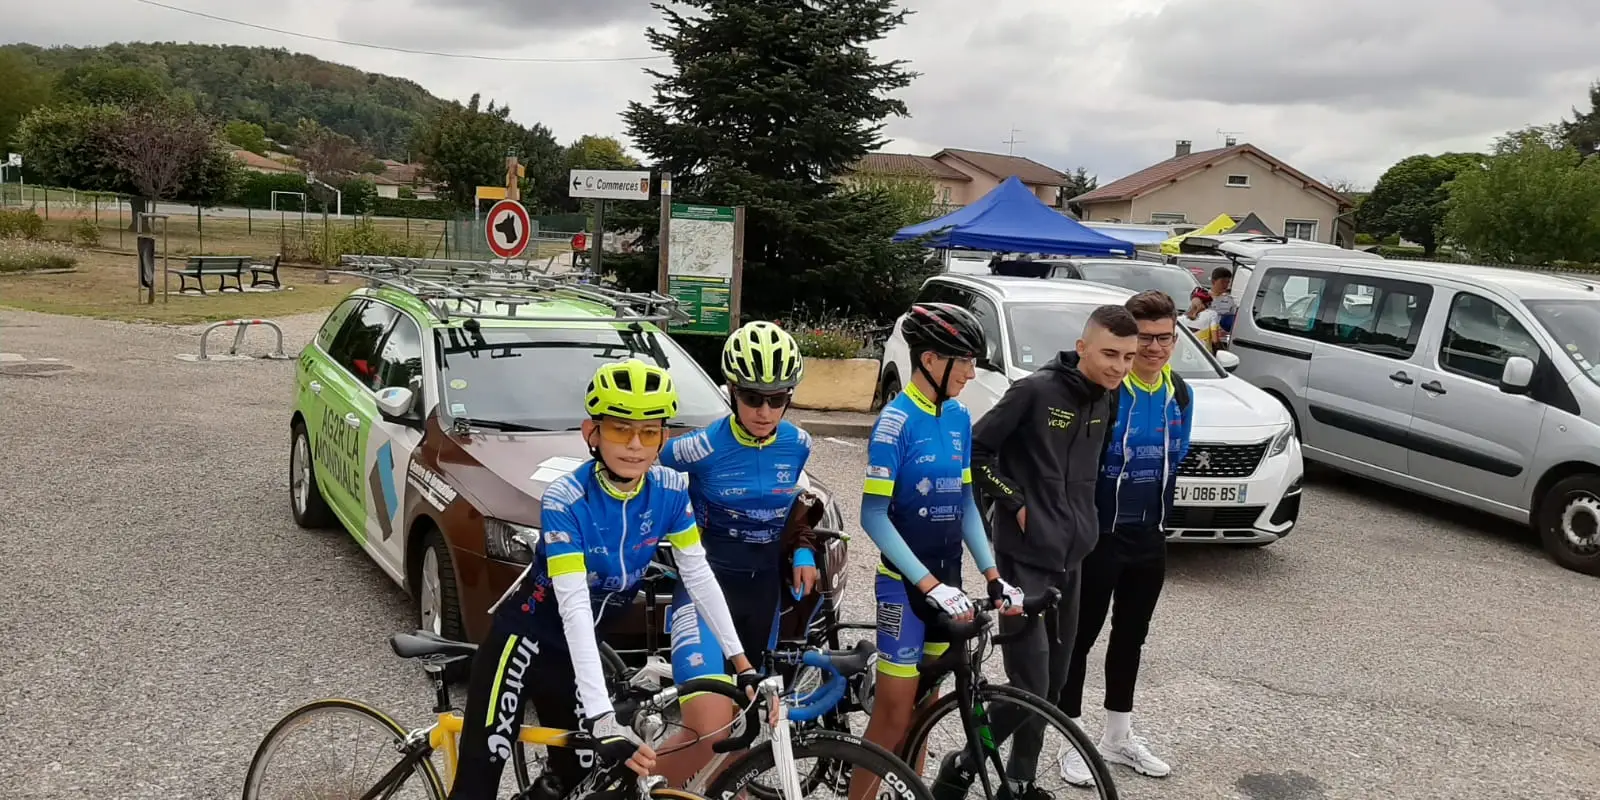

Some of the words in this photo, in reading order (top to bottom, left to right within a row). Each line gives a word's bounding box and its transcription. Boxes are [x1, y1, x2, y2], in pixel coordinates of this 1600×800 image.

[596, 178, 639, 191] Commerces
[321, 404, 345, 450] AG2R
[347, 423, 360, 467] LA
[314, 431, 361, 504] MONDIALE
[735, 768, 760, 790] AERO
